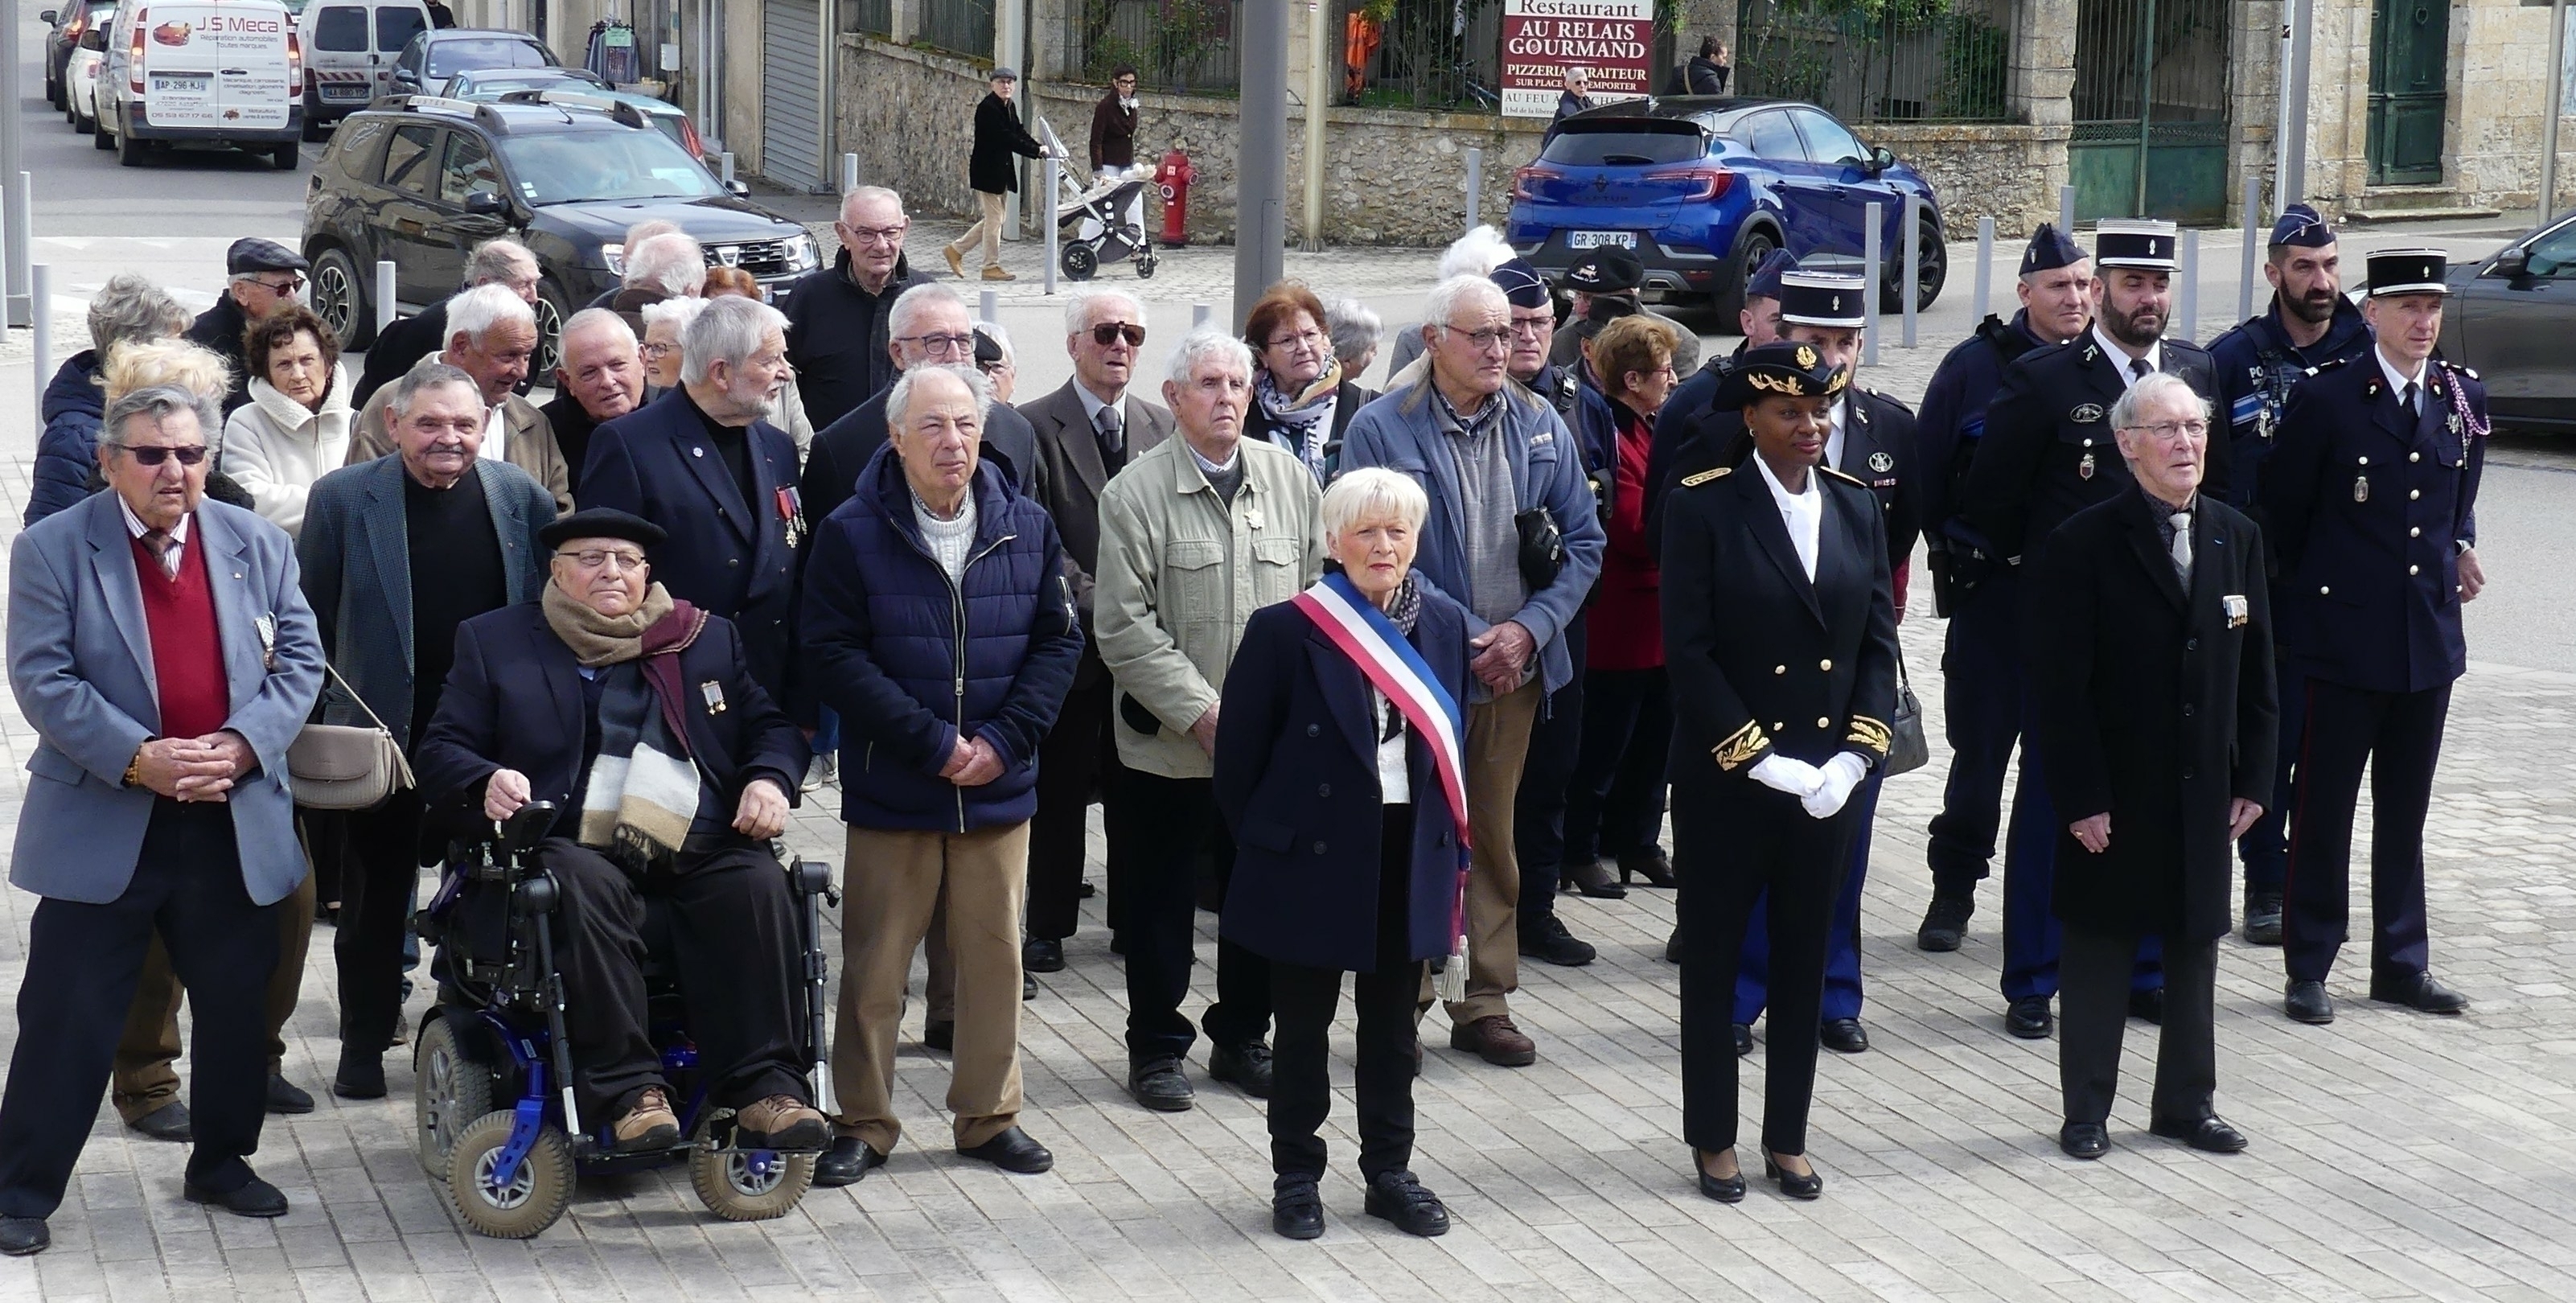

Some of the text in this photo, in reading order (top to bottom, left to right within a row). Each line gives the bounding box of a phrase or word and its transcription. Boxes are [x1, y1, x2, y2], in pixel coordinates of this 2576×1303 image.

[1520, 0, 1639, 17] Restaurant
[228, 18, 278, 33] Meca
[1518, 20, 1635, 40] AU RELAIS
[200, 34, 278, 43] Réparation automobiles
[1509, 38, 1645, 59] GOURMAND
[1506, 64, 1567, 77] PIZZERIA
[1515, 78, 1563, 88] SUR PLACE
[1588, 81, 1637, 91] EMPORTER
[1505, 92, 1521, 102] AU
[1526, 92, 1552, 104] FEU
